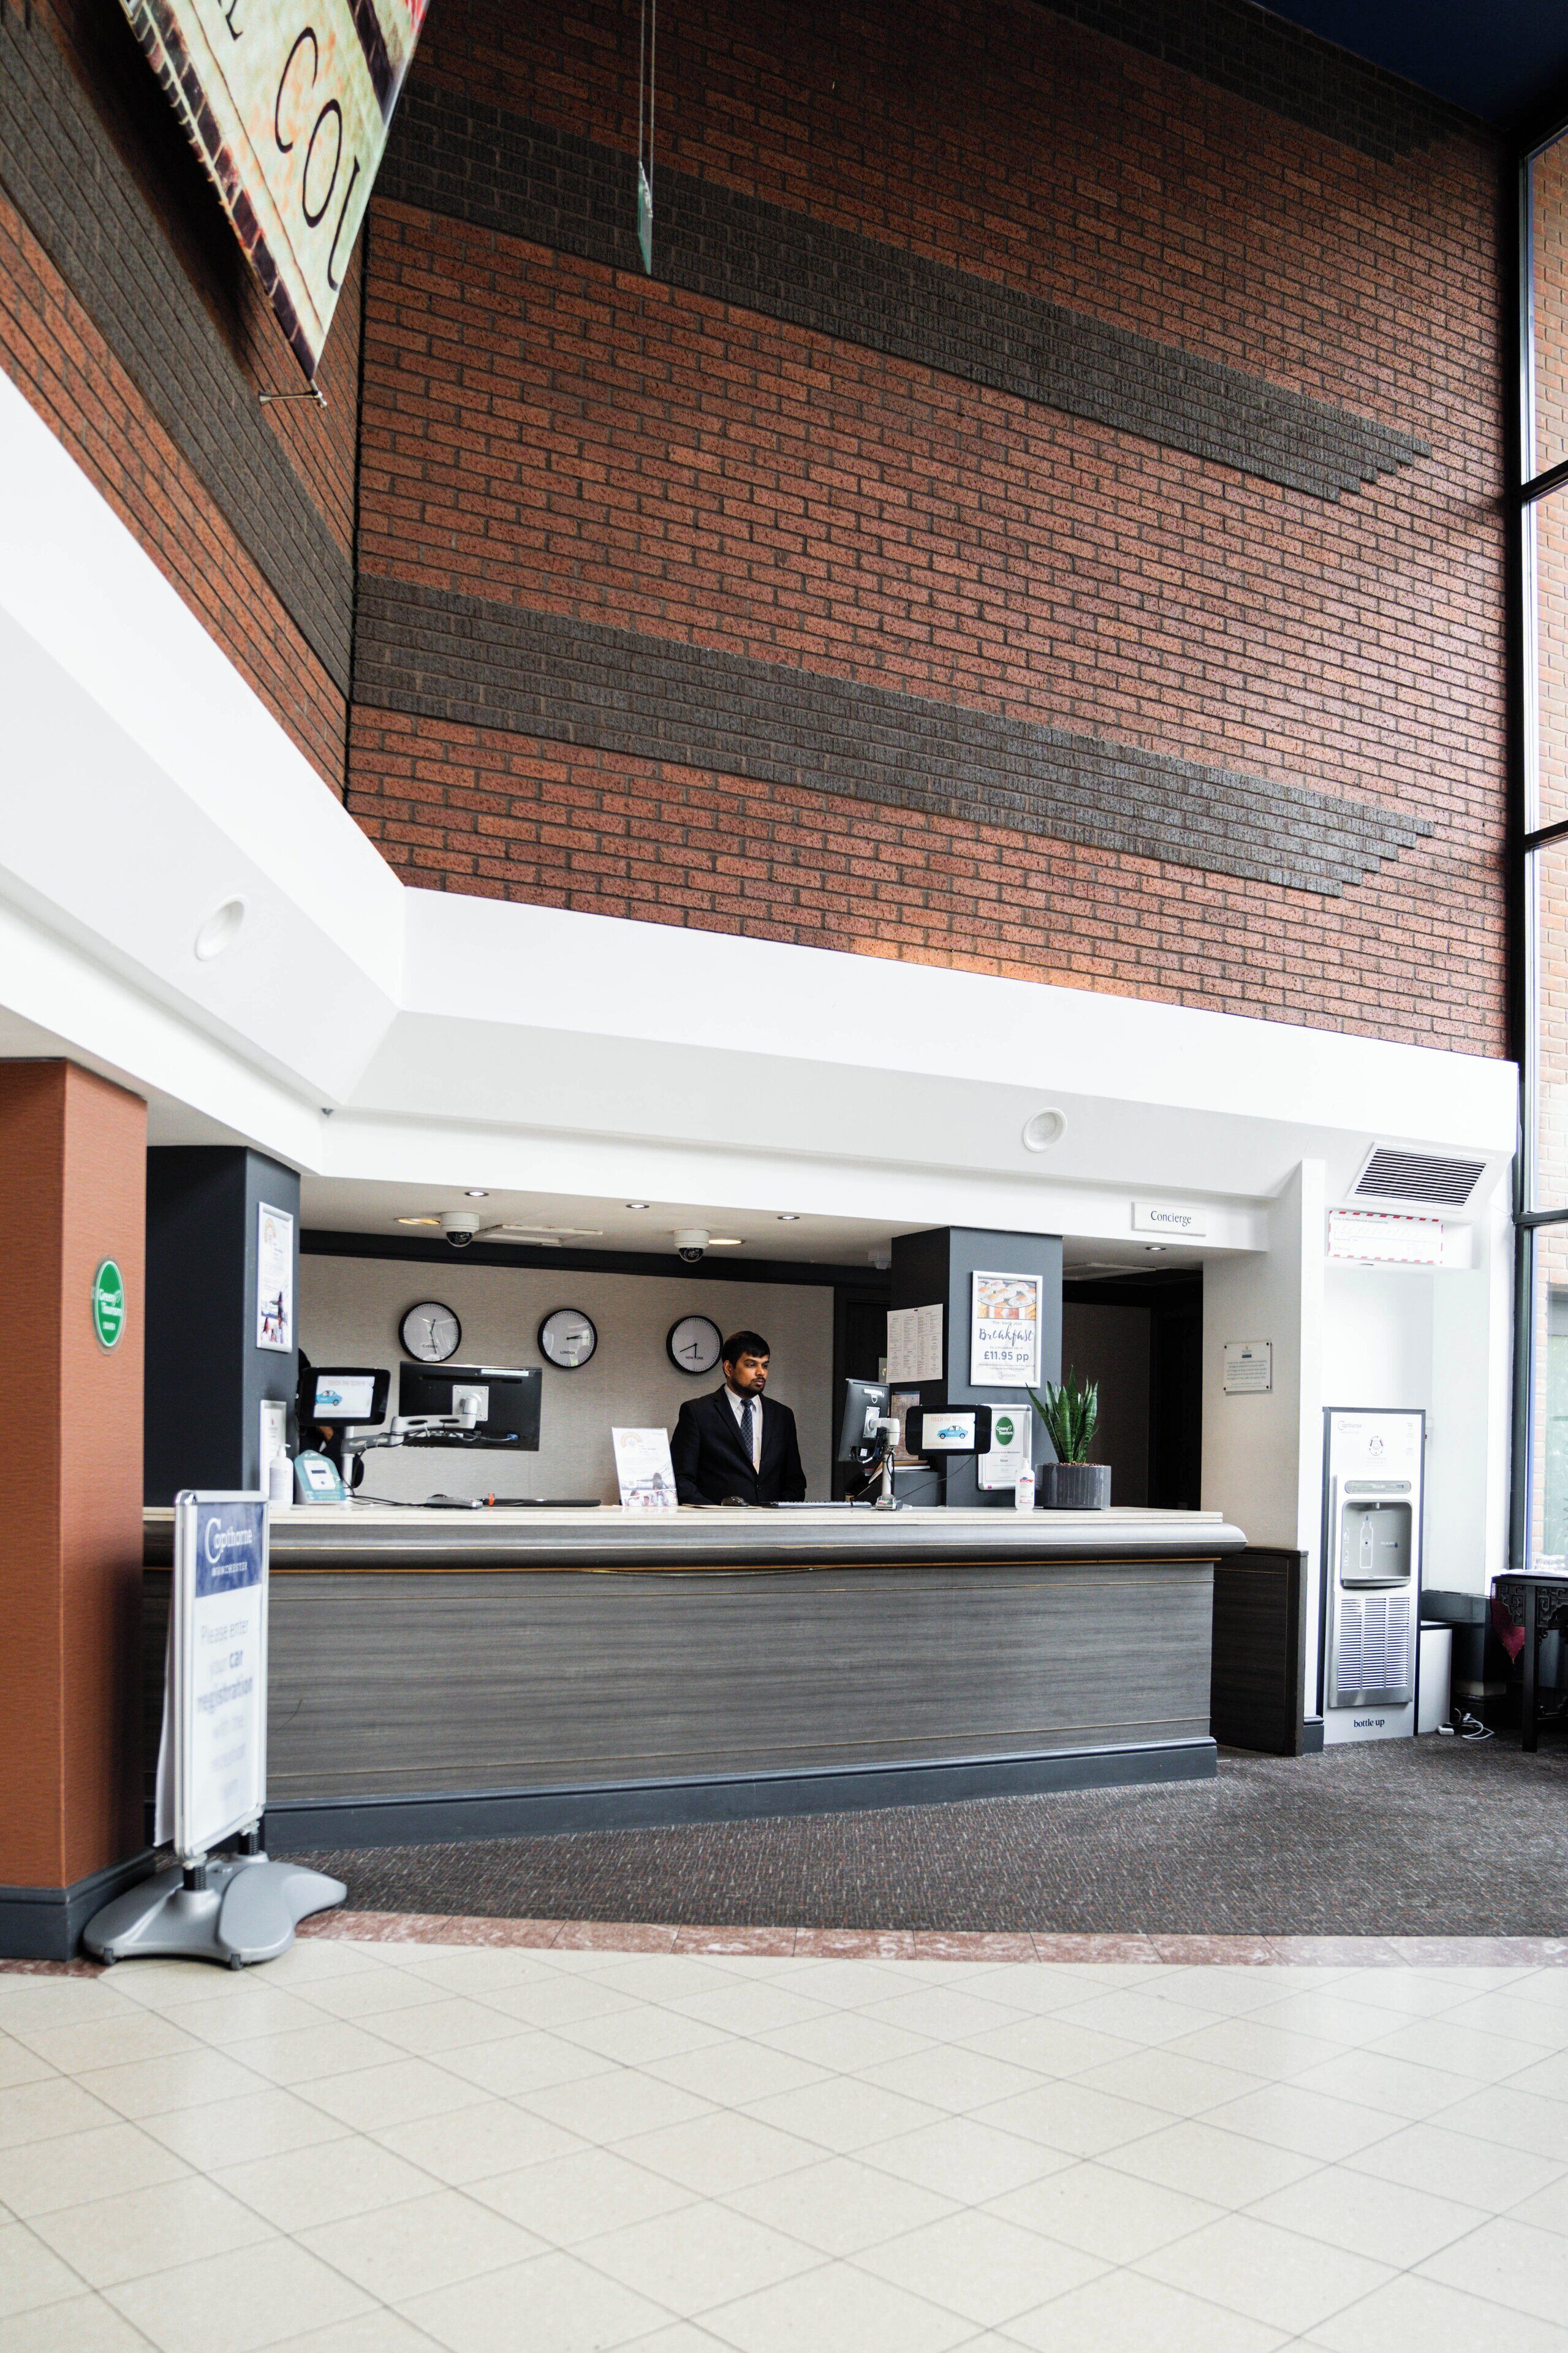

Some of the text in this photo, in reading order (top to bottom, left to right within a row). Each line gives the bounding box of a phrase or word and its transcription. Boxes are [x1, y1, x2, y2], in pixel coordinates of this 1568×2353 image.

[1150, 1211, 1192, 1227] Concierge
[979, 1324, 1034, 1347] Breakfast
[984, 1351, 1029, 1362] £11.95 pp
[1338, 1420, 1363, 1430] Copthorne
[205, 1517, 252, 1564] Copthorne
[211, 1561, 248, 1577] MANCHESTER
[202, 1620, 249, 1644] Please enter
[229, 1649, 243, 1669] car
[197, 1674, 253, 1715] registration
[1354, 1718, 1374, 1727] bottle
